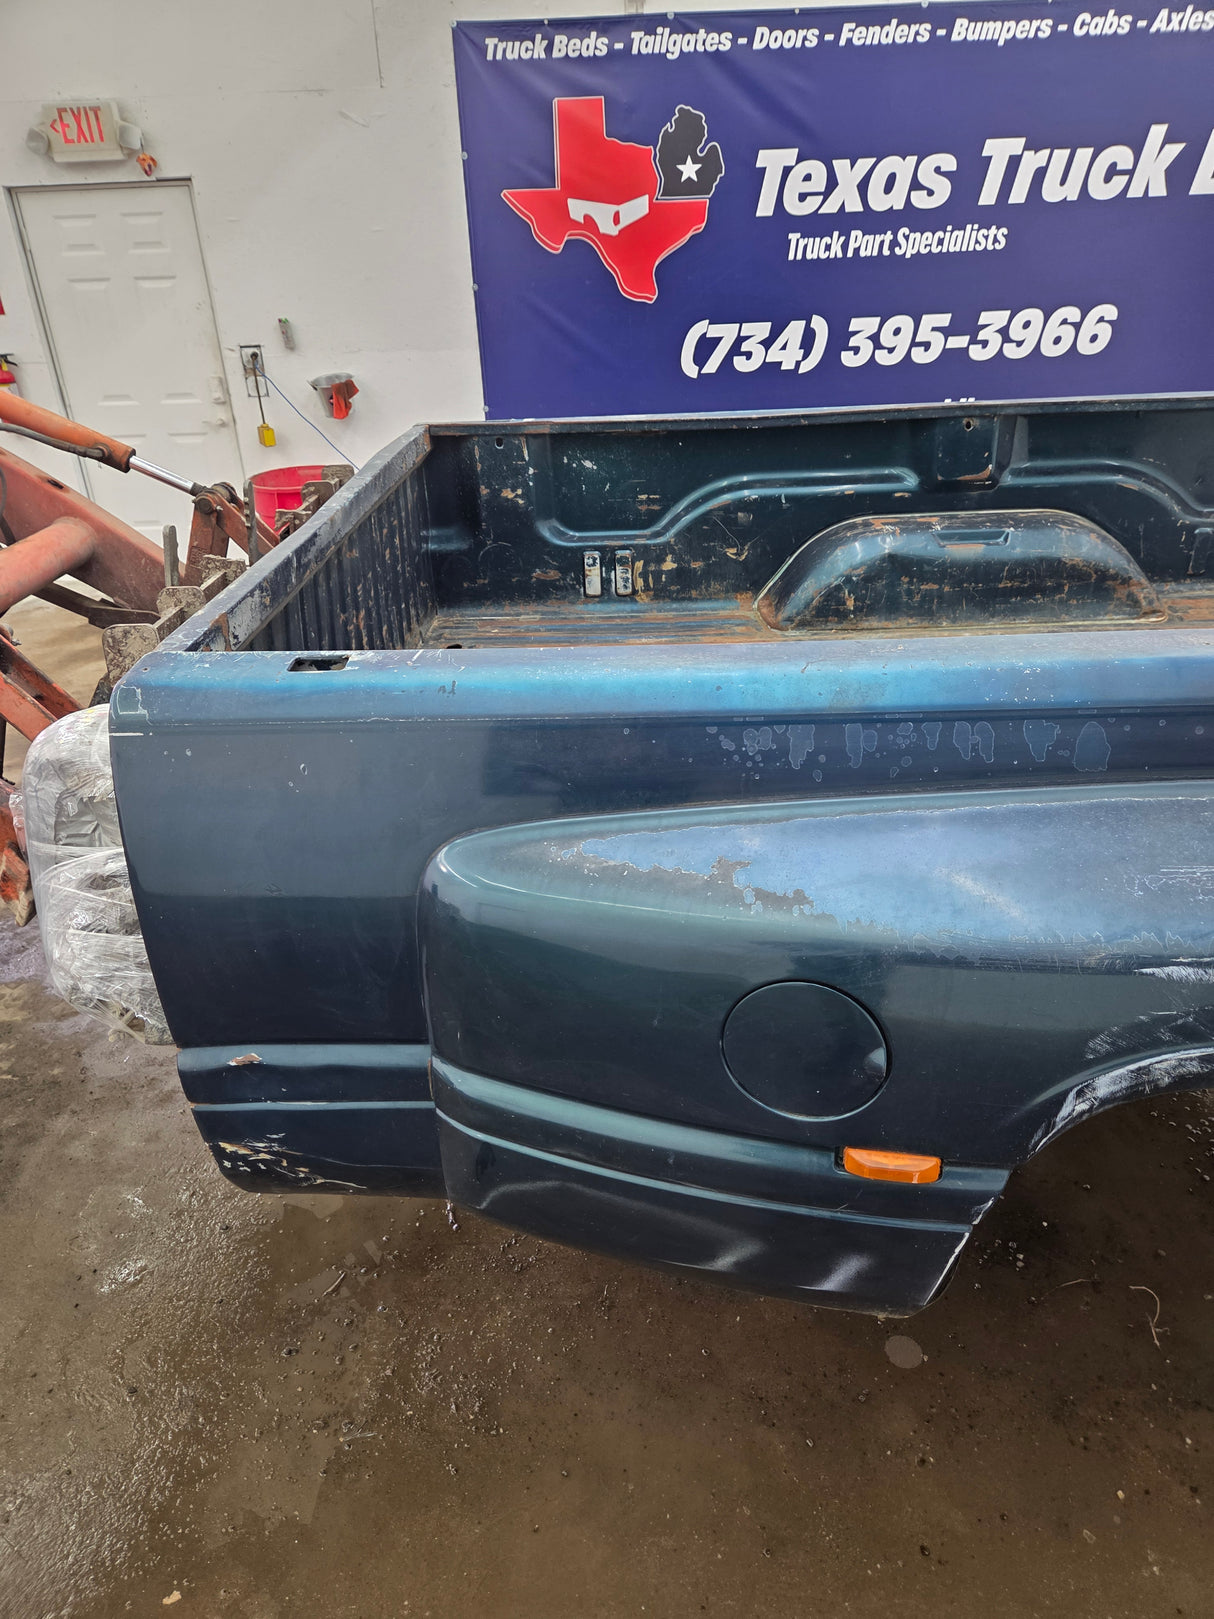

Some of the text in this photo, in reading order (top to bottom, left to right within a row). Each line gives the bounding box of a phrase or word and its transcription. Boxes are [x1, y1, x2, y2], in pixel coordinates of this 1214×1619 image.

[484, 33, 548, 61] Truck
[551, 31, 609, 59] Beds
[630, 26, 733, 60] Tailgates
[752, 26, 820, 50] Doors
[838, 18, 932, 47] Fenders
[950, 17, 1054, 47] Bumpers
[1072, 8, 1133, 37] Cabs
[1149, 4, 1214, 34] Axles
[56, 105, 105, 145] EXIT
[755, 147, 958, 218] Texas
[977, 123, 1187, 206] Truck
[787, 223, 1009, 261] Truck Part Specialists
[680, 303, 1119, 379] (734) 395-3966
